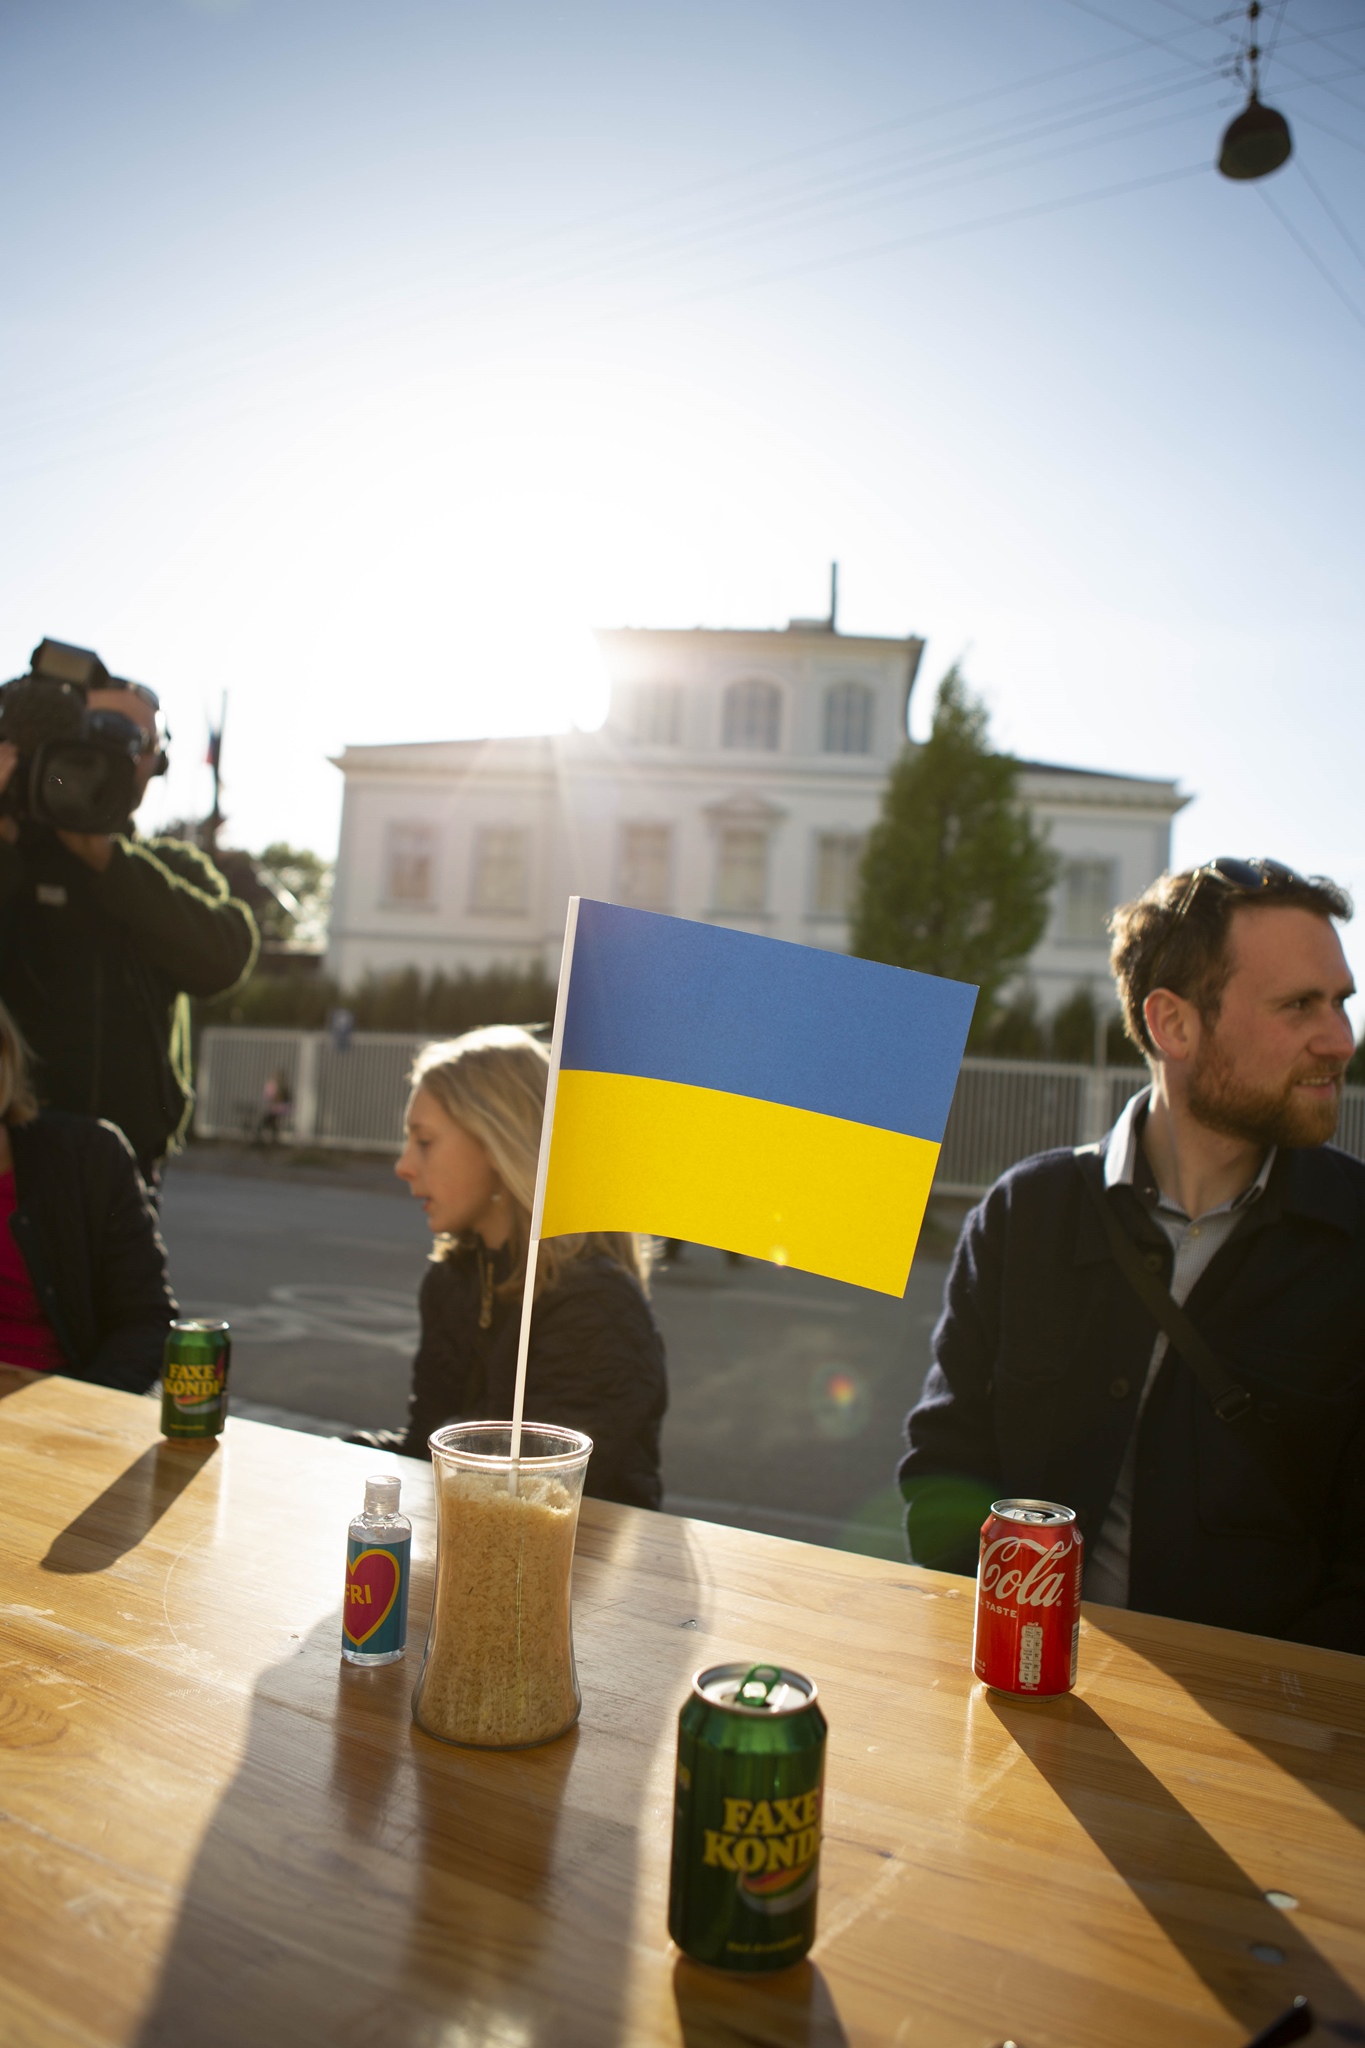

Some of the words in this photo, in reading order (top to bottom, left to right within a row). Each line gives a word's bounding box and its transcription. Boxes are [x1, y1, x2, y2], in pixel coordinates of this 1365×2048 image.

[164, 1377, 220, 1397] KONDI
[168, 1363, 215, 1381] FAXE
[979, 1536, 1073, 1607] Cola
[985, 1600, 1018, 1619] TASTE
[723, 1789, 818, 1836] FAXE
[703, 1827, 820, 1873] KOND
